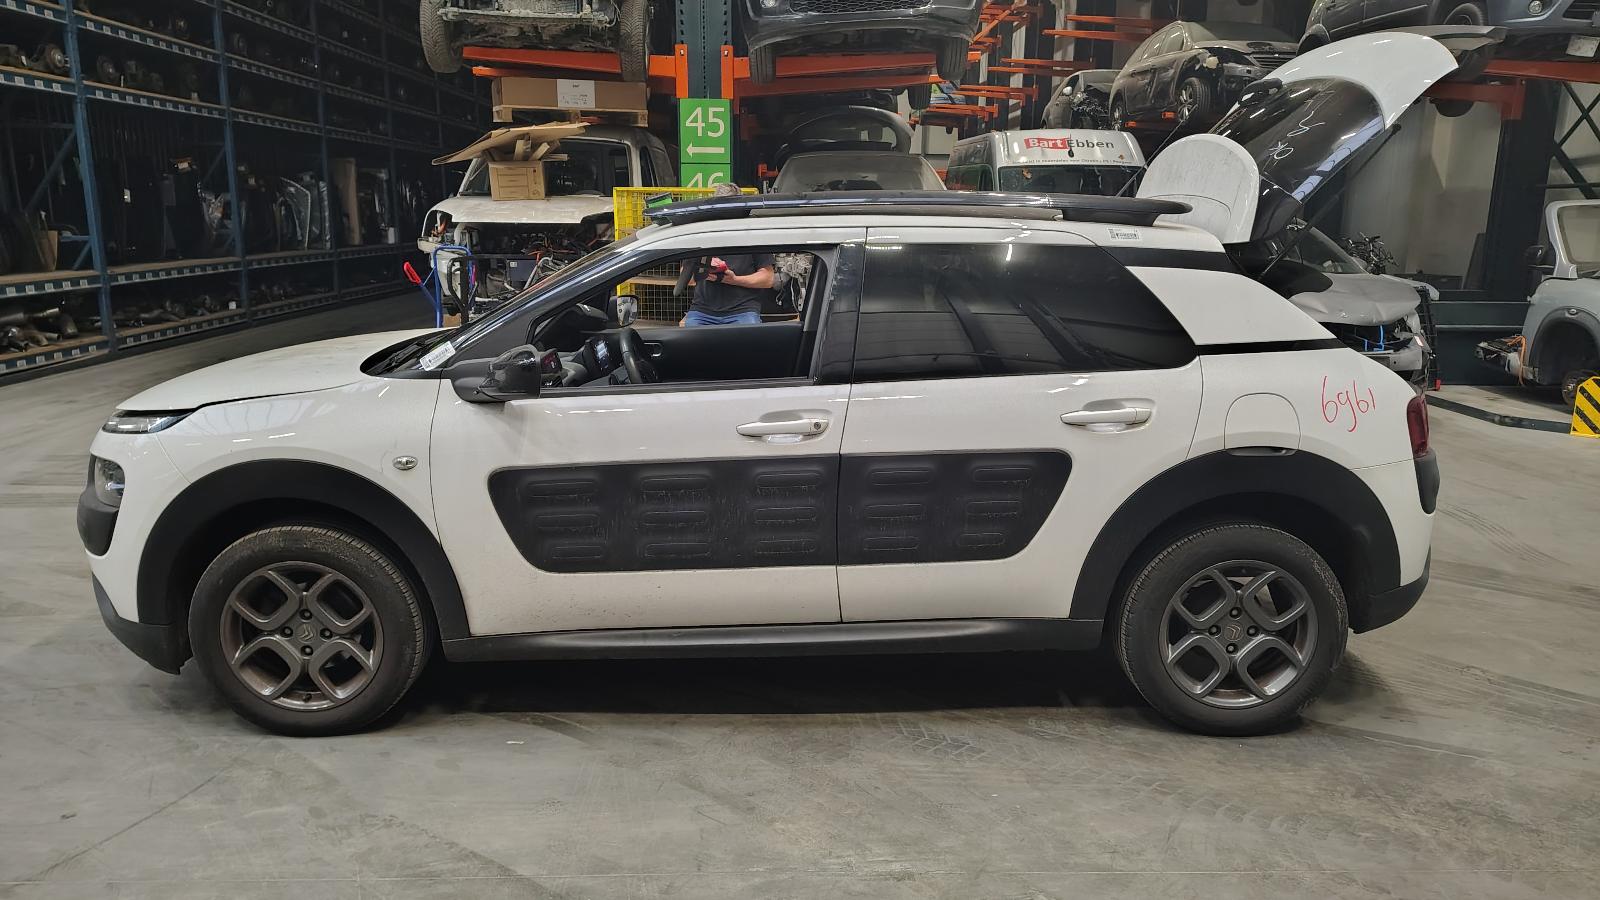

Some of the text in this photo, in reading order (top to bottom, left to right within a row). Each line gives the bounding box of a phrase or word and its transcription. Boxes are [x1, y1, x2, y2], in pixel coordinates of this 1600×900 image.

[685, 106, 725, 138] 45
[1028, 138, 1115, 149] Bart Ebben
[1321, 375, 1376, 432] 6961
